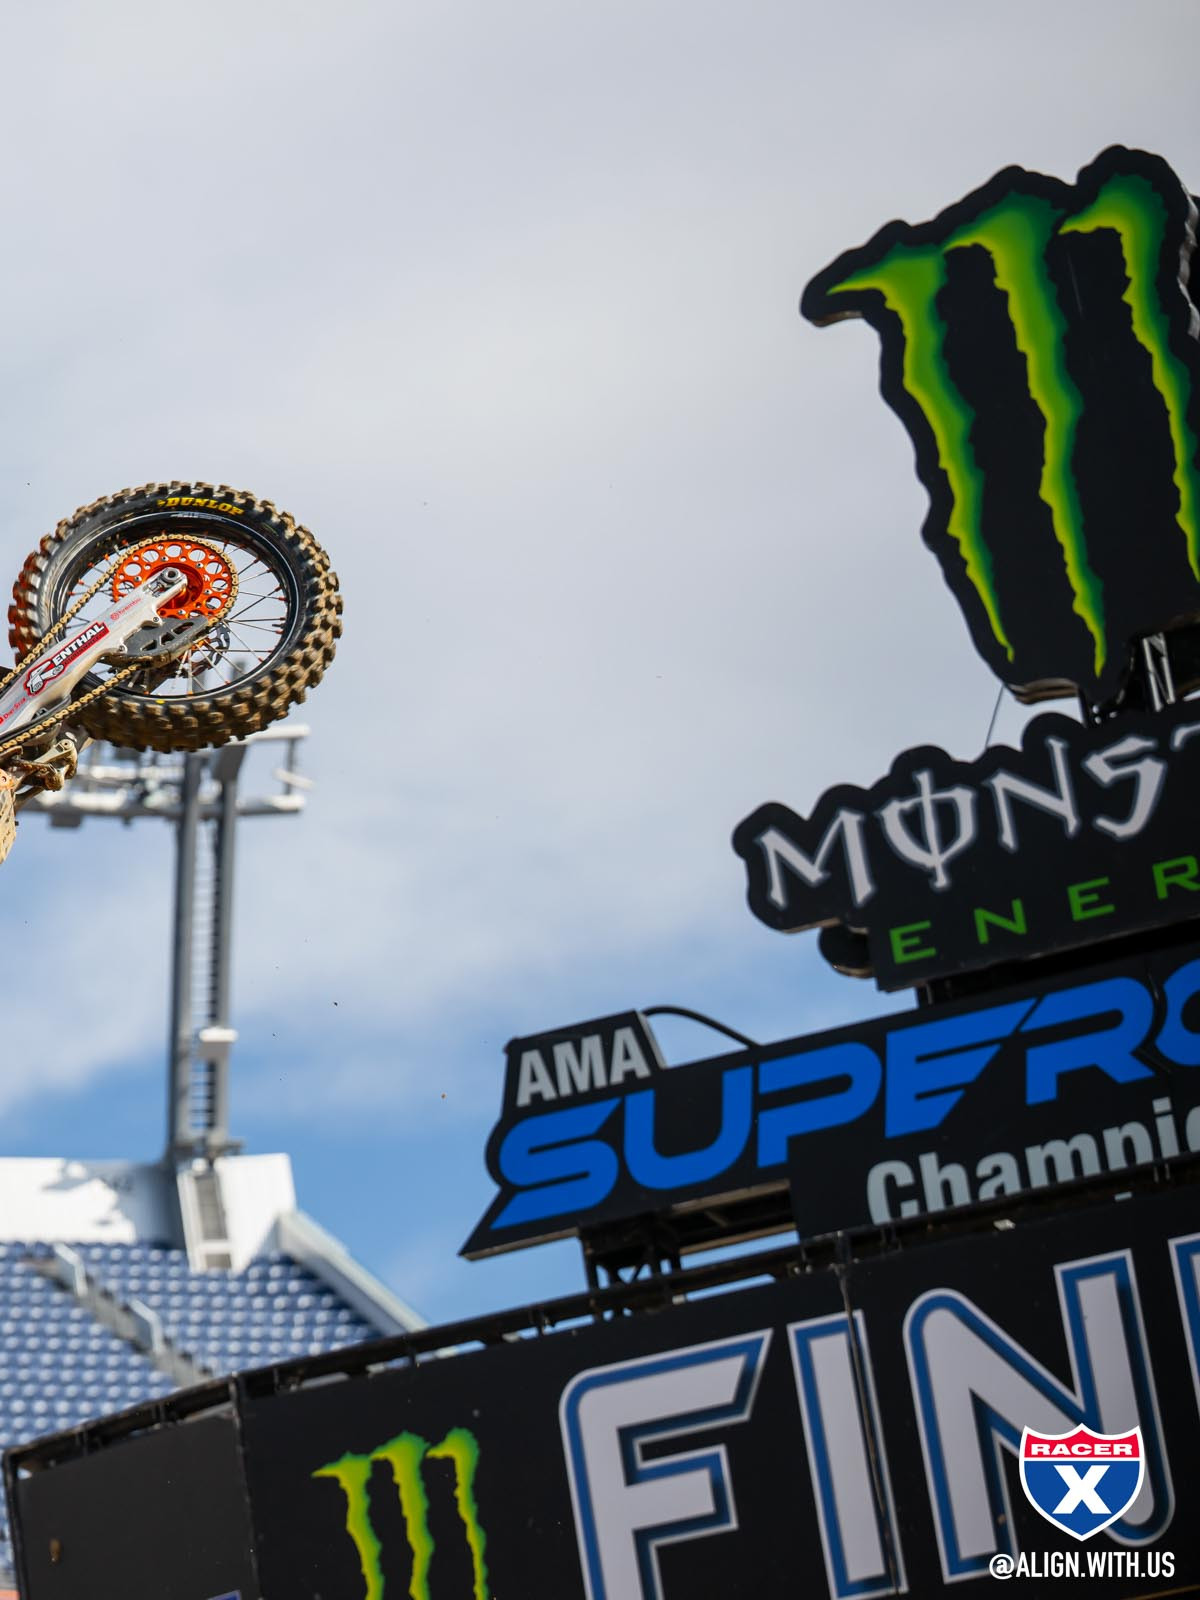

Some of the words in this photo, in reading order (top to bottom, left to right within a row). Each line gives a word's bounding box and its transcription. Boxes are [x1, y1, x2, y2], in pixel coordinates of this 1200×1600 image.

[166, 497, 244, 516] DUNLOP
[28, 622, 105, 693] RENTHAL
[516, 1025, 650, 1108] AMA
